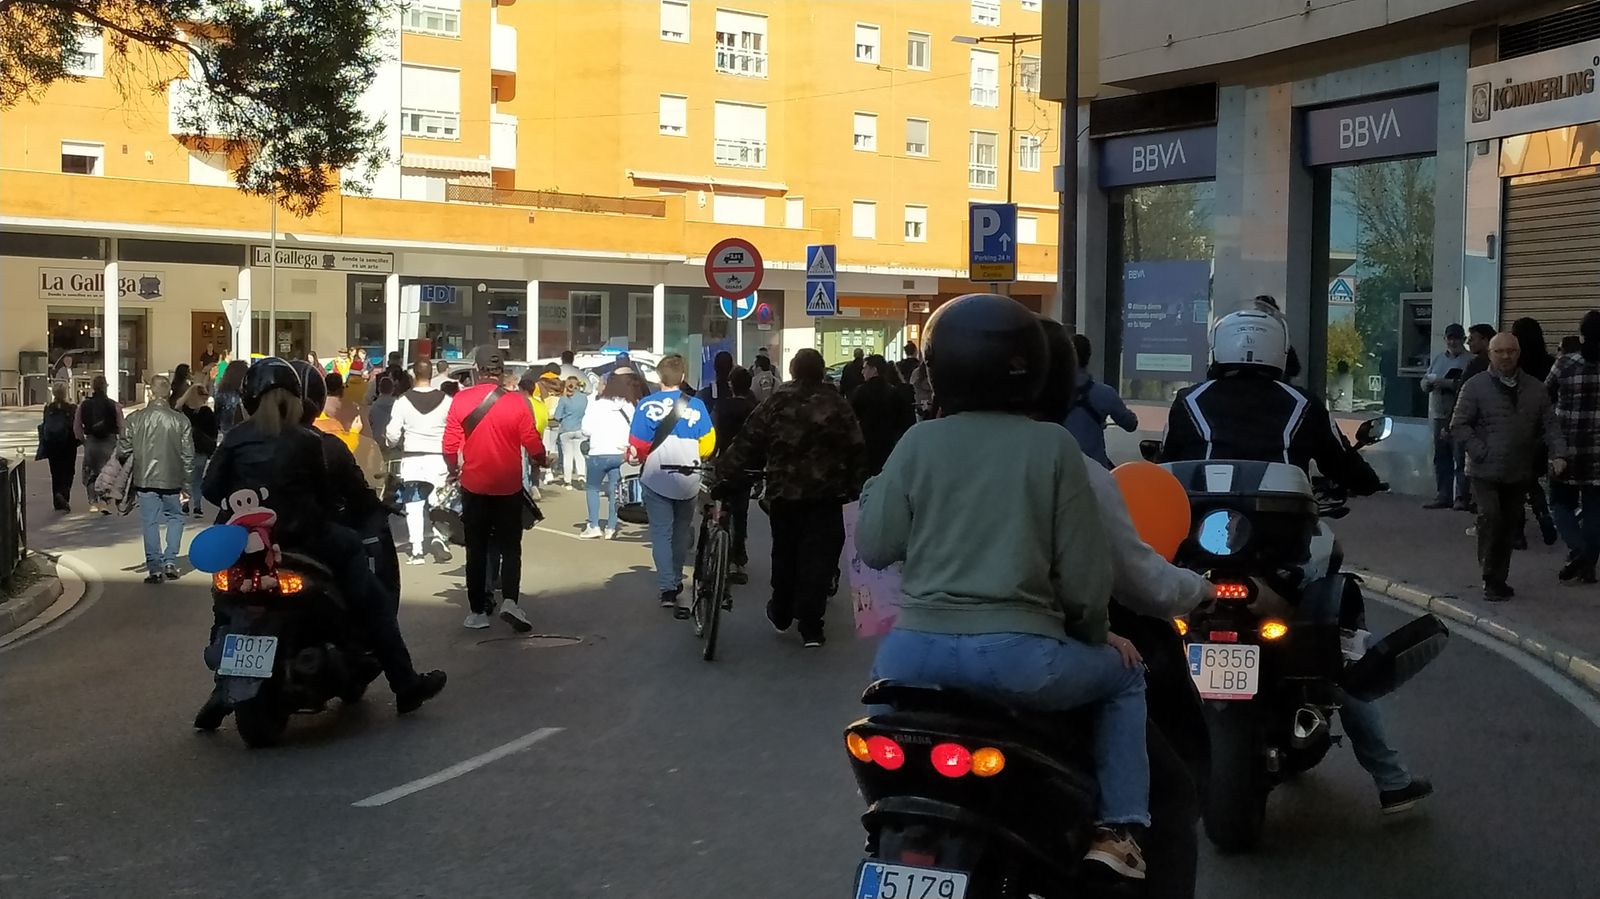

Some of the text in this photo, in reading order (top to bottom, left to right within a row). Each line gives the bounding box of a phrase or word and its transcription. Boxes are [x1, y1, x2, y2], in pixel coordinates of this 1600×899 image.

[1493, 68, 1595, 112] KÖMMERLING
[1339, 107, 1401, 149] BBVA
[1132, 137, 1187, 173] BBVA
[973, 208, 1001, 252] P
[256, 249, 318, 269] La Gallega
[42, 273, 137, 298] La Gallga
[235, 638, 274, 653] 0017
[235, 654, 264, 669] HSC
[1204, 648, 1256, 669] 6356
[1209, 670, 1248, 690] LBB
[880, 871, 956, 899] 5179
